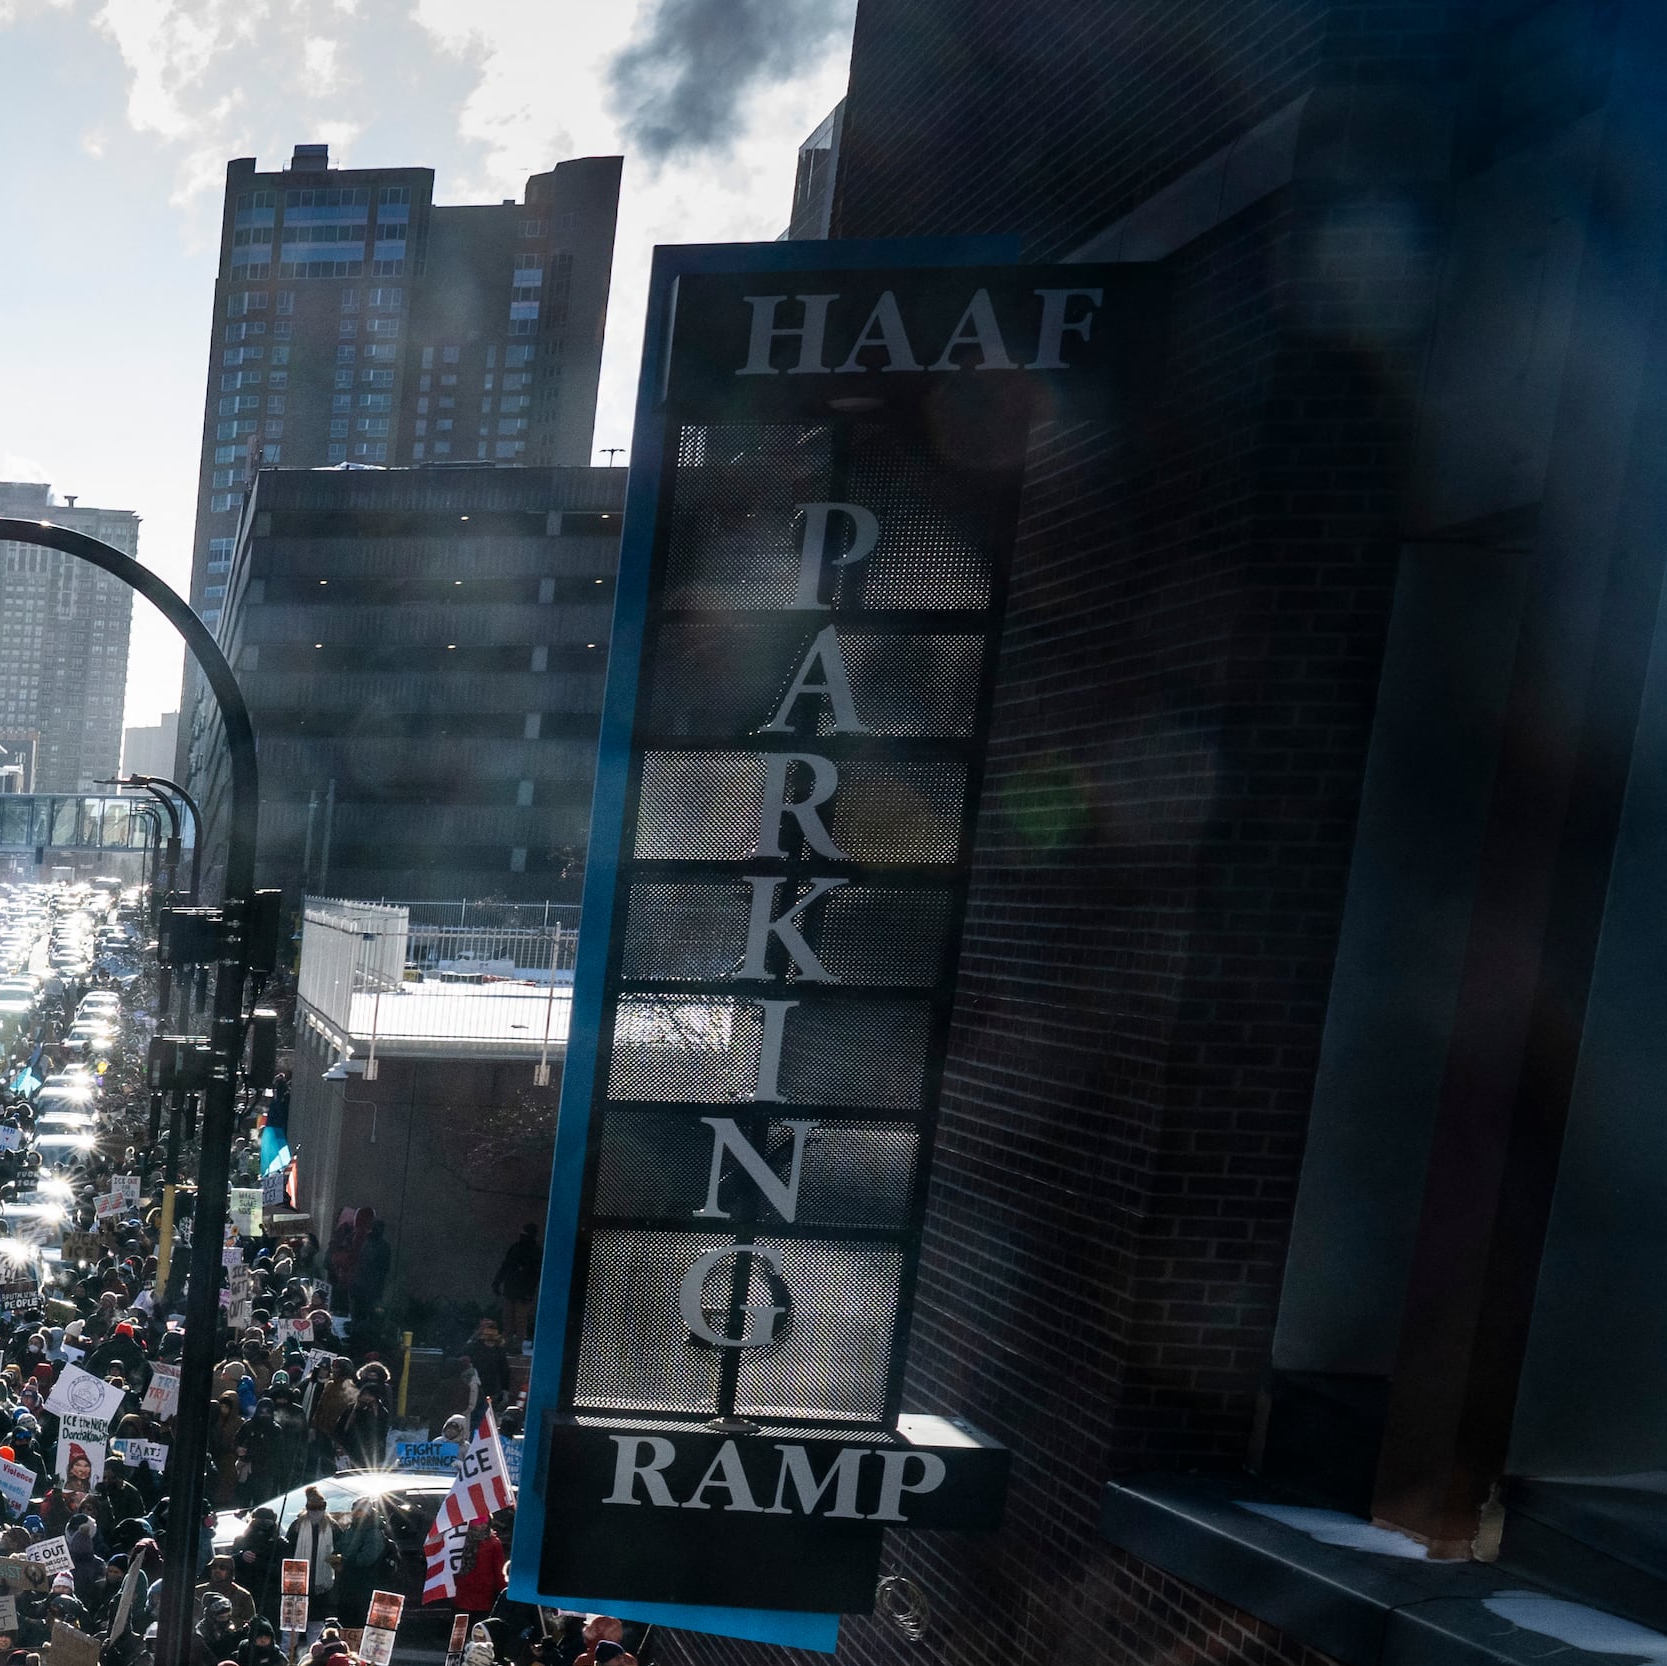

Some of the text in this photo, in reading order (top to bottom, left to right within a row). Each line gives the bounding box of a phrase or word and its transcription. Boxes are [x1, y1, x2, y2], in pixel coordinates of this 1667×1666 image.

[736, 288, 1103, 375] HAAF
[678, 502, 880, 1348] PARKING
[602, 1434, 946, 1521] RAMP
